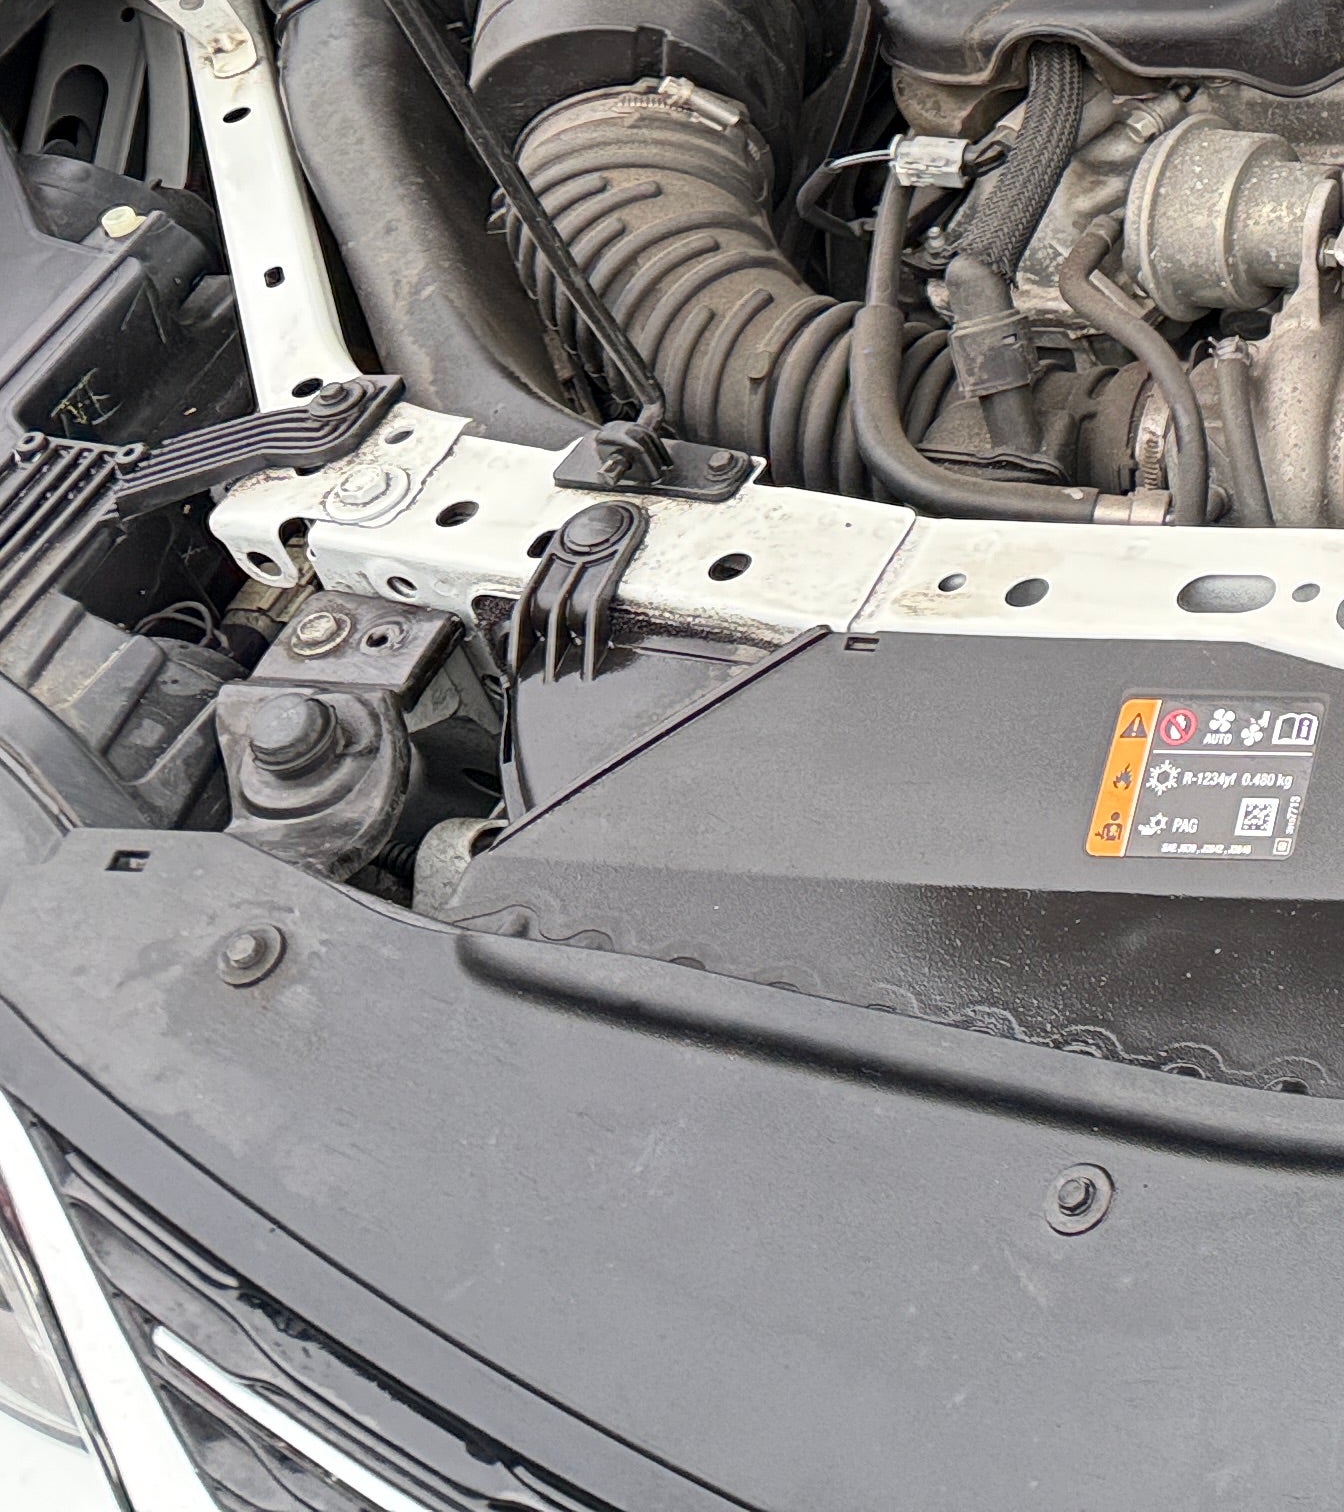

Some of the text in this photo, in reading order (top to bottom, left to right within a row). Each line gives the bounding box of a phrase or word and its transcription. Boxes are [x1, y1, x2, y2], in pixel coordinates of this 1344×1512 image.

[1203, 732, 1233, 745] AUTO
[1182, 771, 1237, 789] R-1234yf
[1277, 774, 1293, 790] kg
[1171, 817, 1199, 834] PAG
